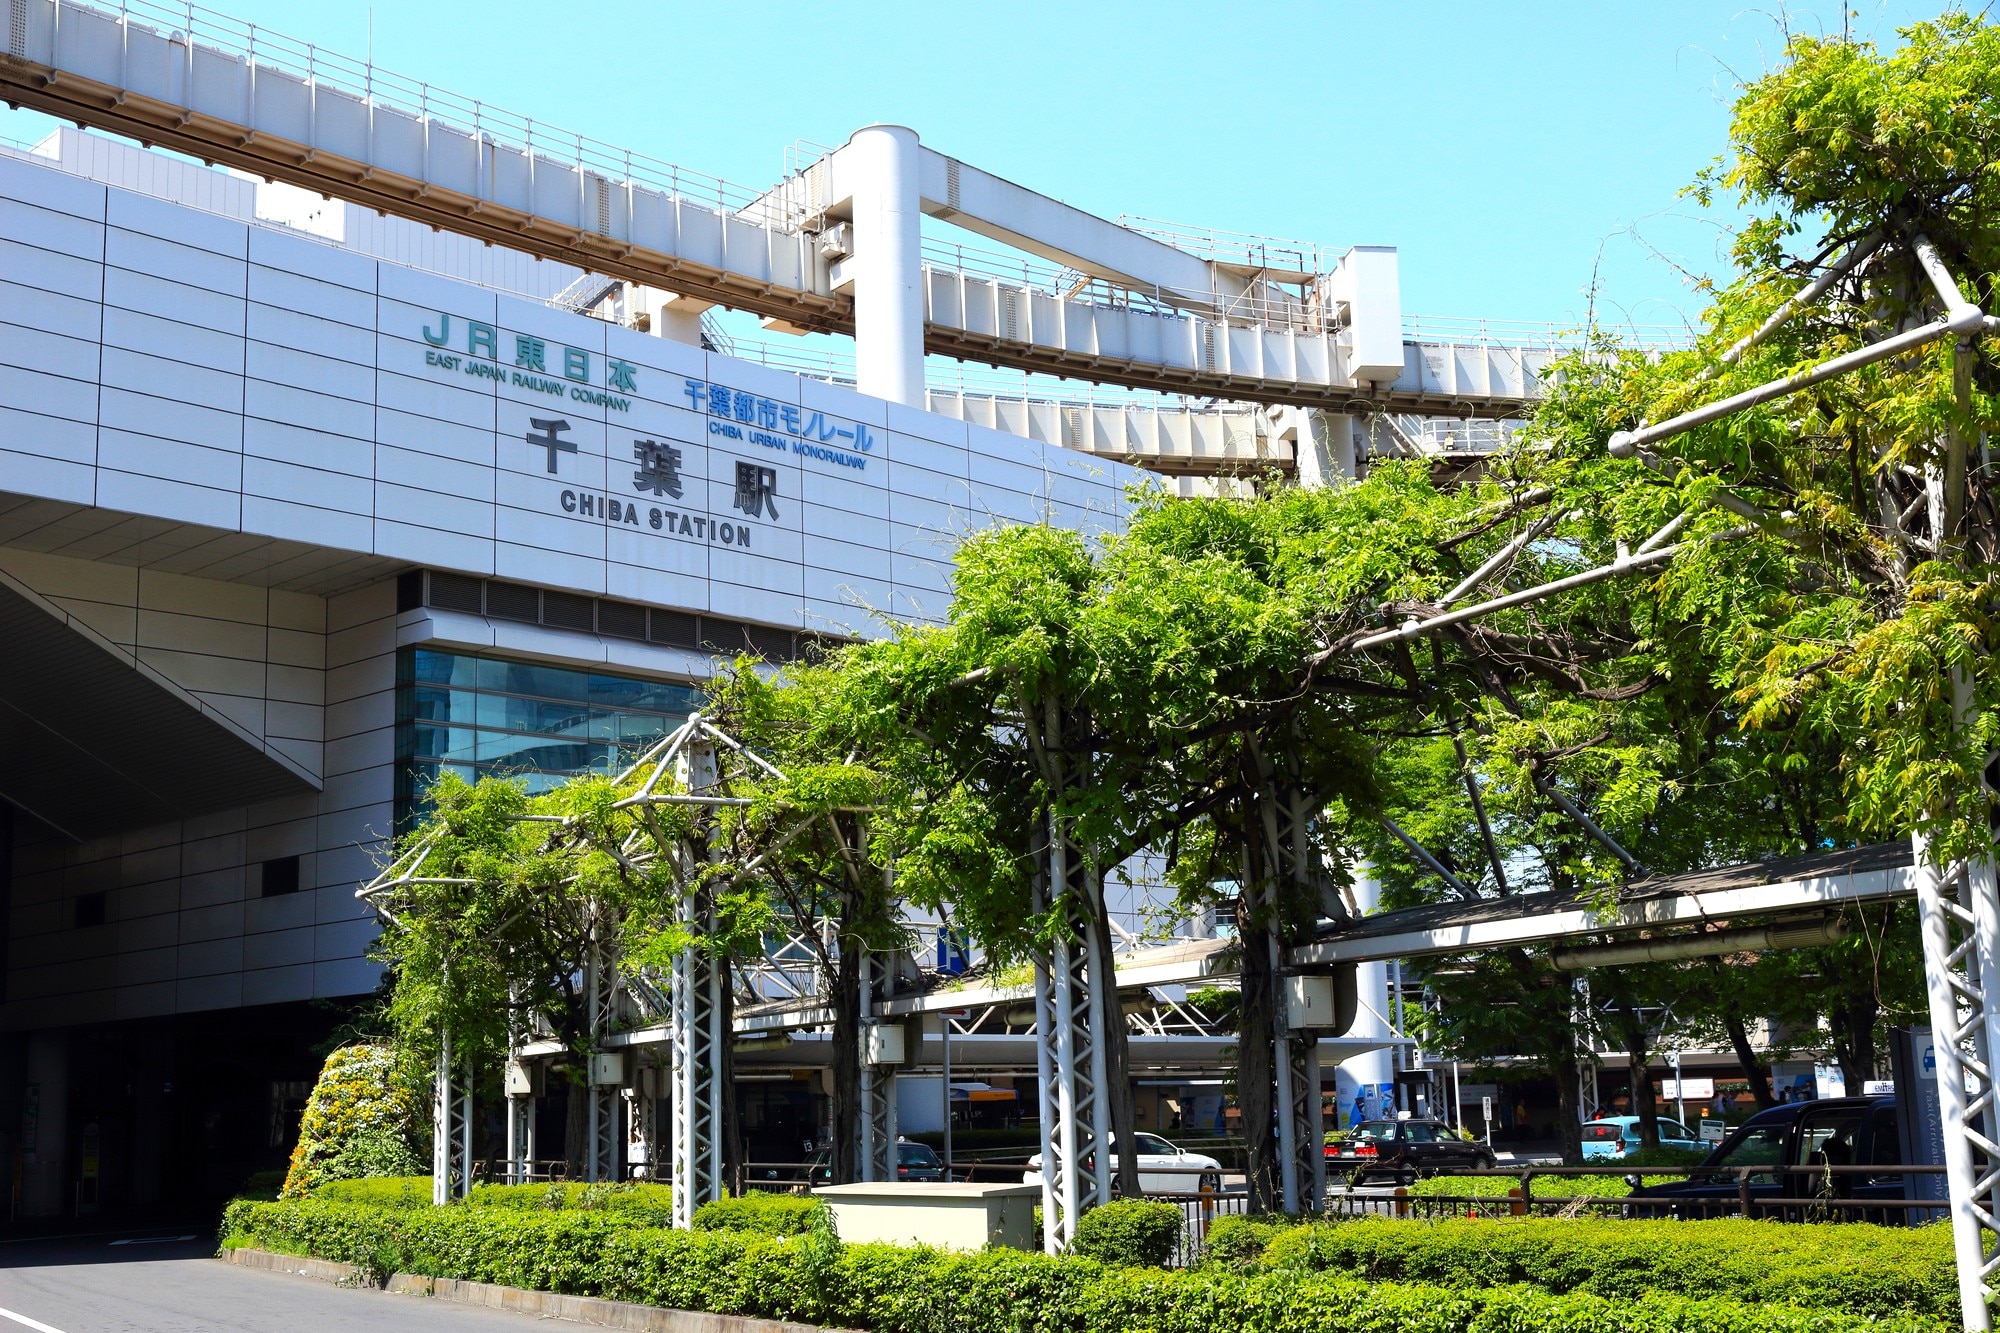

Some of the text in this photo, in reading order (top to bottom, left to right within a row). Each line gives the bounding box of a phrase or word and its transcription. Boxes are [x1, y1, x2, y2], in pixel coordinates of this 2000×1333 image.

[422, 314, 637, 392] JR東日本
[425, 351, 631, 412] EAST JAPAN RAILWAY COMPANY
[684, 380, 874, 451] 千葉都市モノレール
[709, 421, 867, 470] CHIBA URBAN MONORAILWAY
[526, 417, 779, 521] 千葉駅
[560, 489, 750, 548] CHIBA STATION
